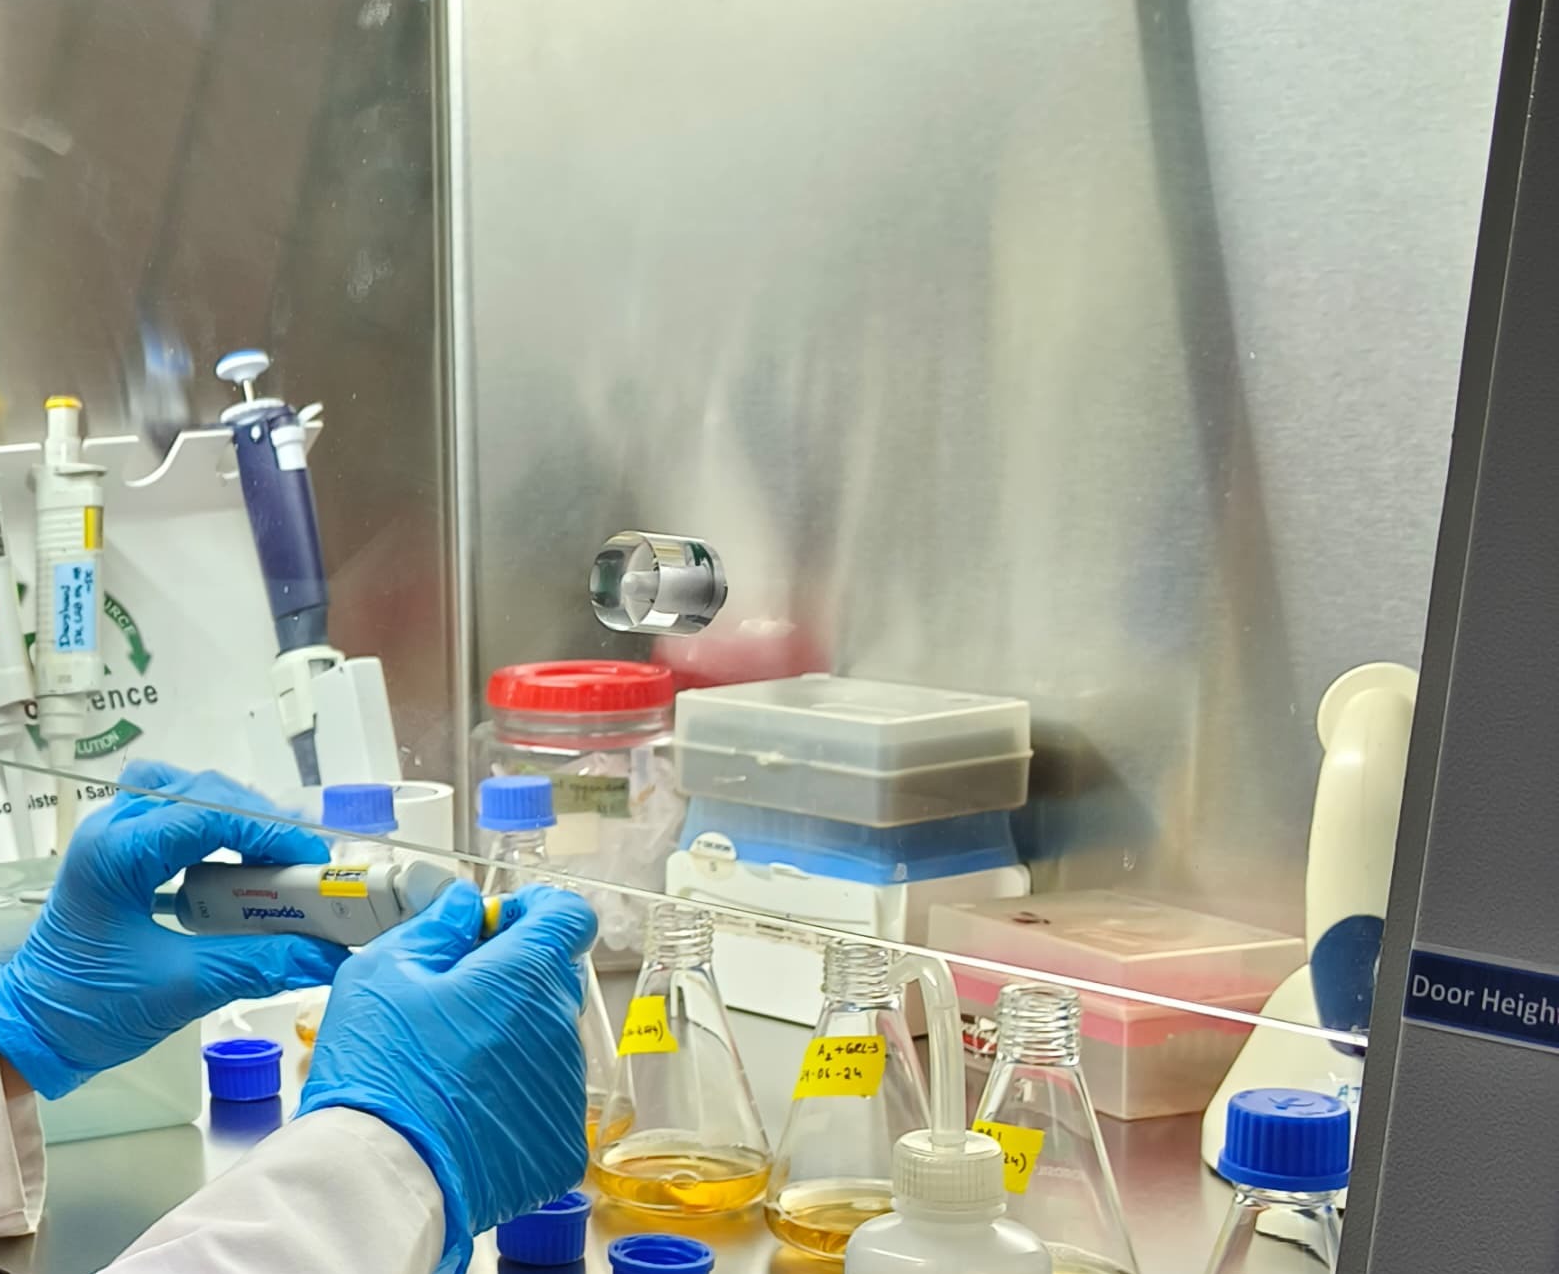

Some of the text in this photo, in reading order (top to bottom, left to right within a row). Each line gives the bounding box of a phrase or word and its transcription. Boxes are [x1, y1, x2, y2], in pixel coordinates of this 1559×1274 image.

[241, 906, 306, 920] eppendorf
[1411, 973, 1559, 1026] Door Heigh
